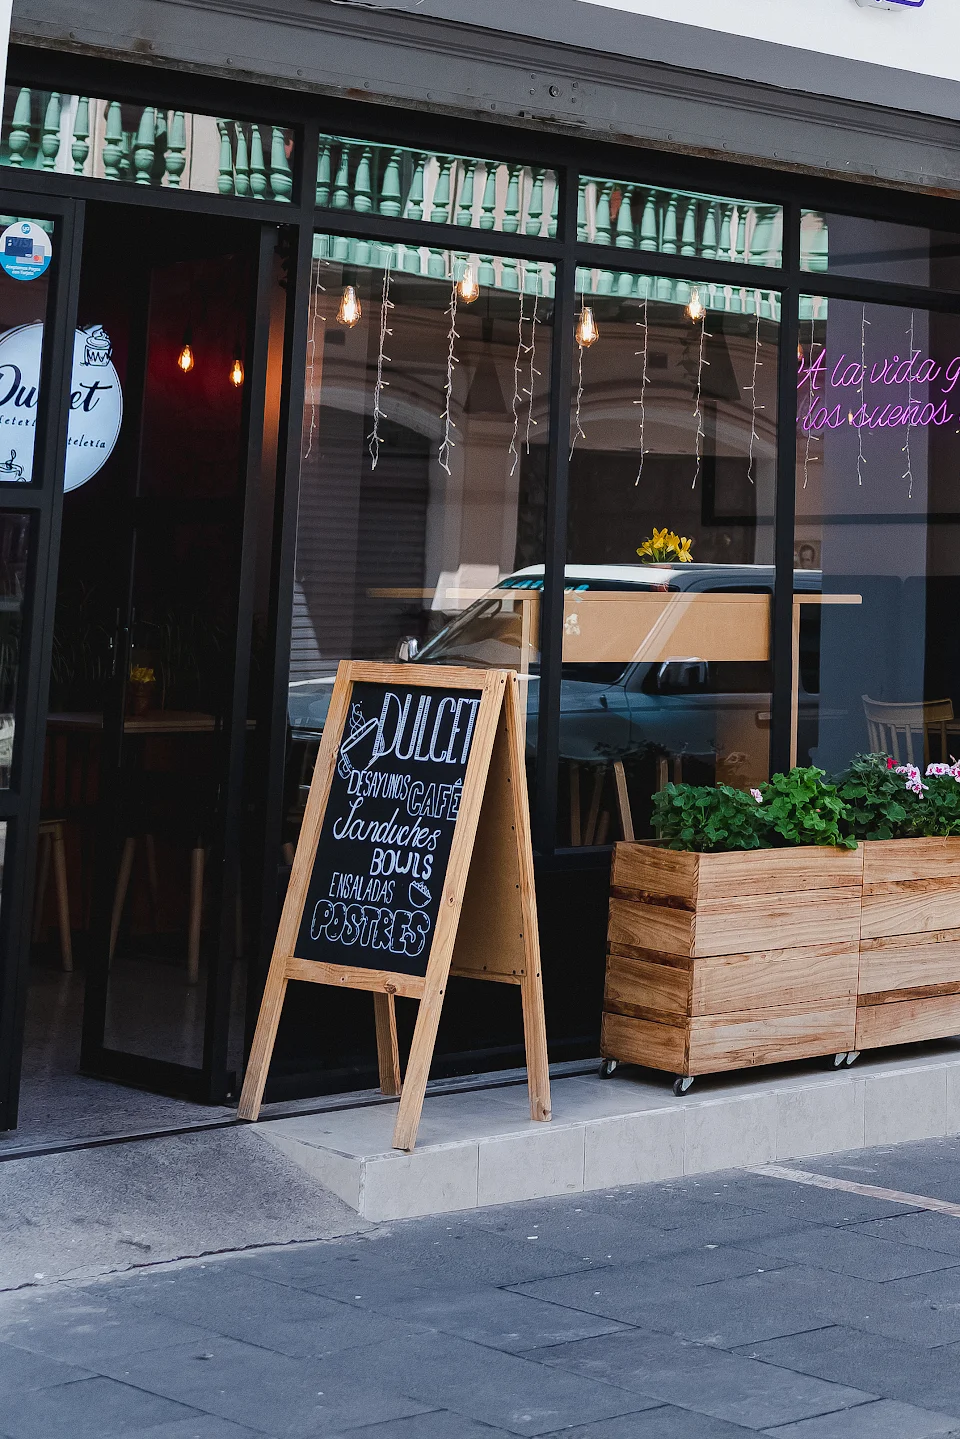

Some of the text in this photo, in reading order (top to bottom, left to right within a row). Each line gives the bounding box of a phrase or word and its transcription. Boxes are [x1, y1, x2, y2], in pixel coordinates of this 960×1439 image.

[831, 354, 866, 387] la
[870, 351, 942, 385] vida
[803, 396, 846, 431] los
[852, 399, 954, 429] sueños
[372, 692, 481, 765] DULCET
[347, 769, 463, 821] DESAYUNOS CAFÉ
[332, 796, 442, 851] Sanduches
[369, 848, 434, 881] BOWLS
[328, 871, 396, 904] ENSALADAS
[310, 899, 431, 957] POSTRES
